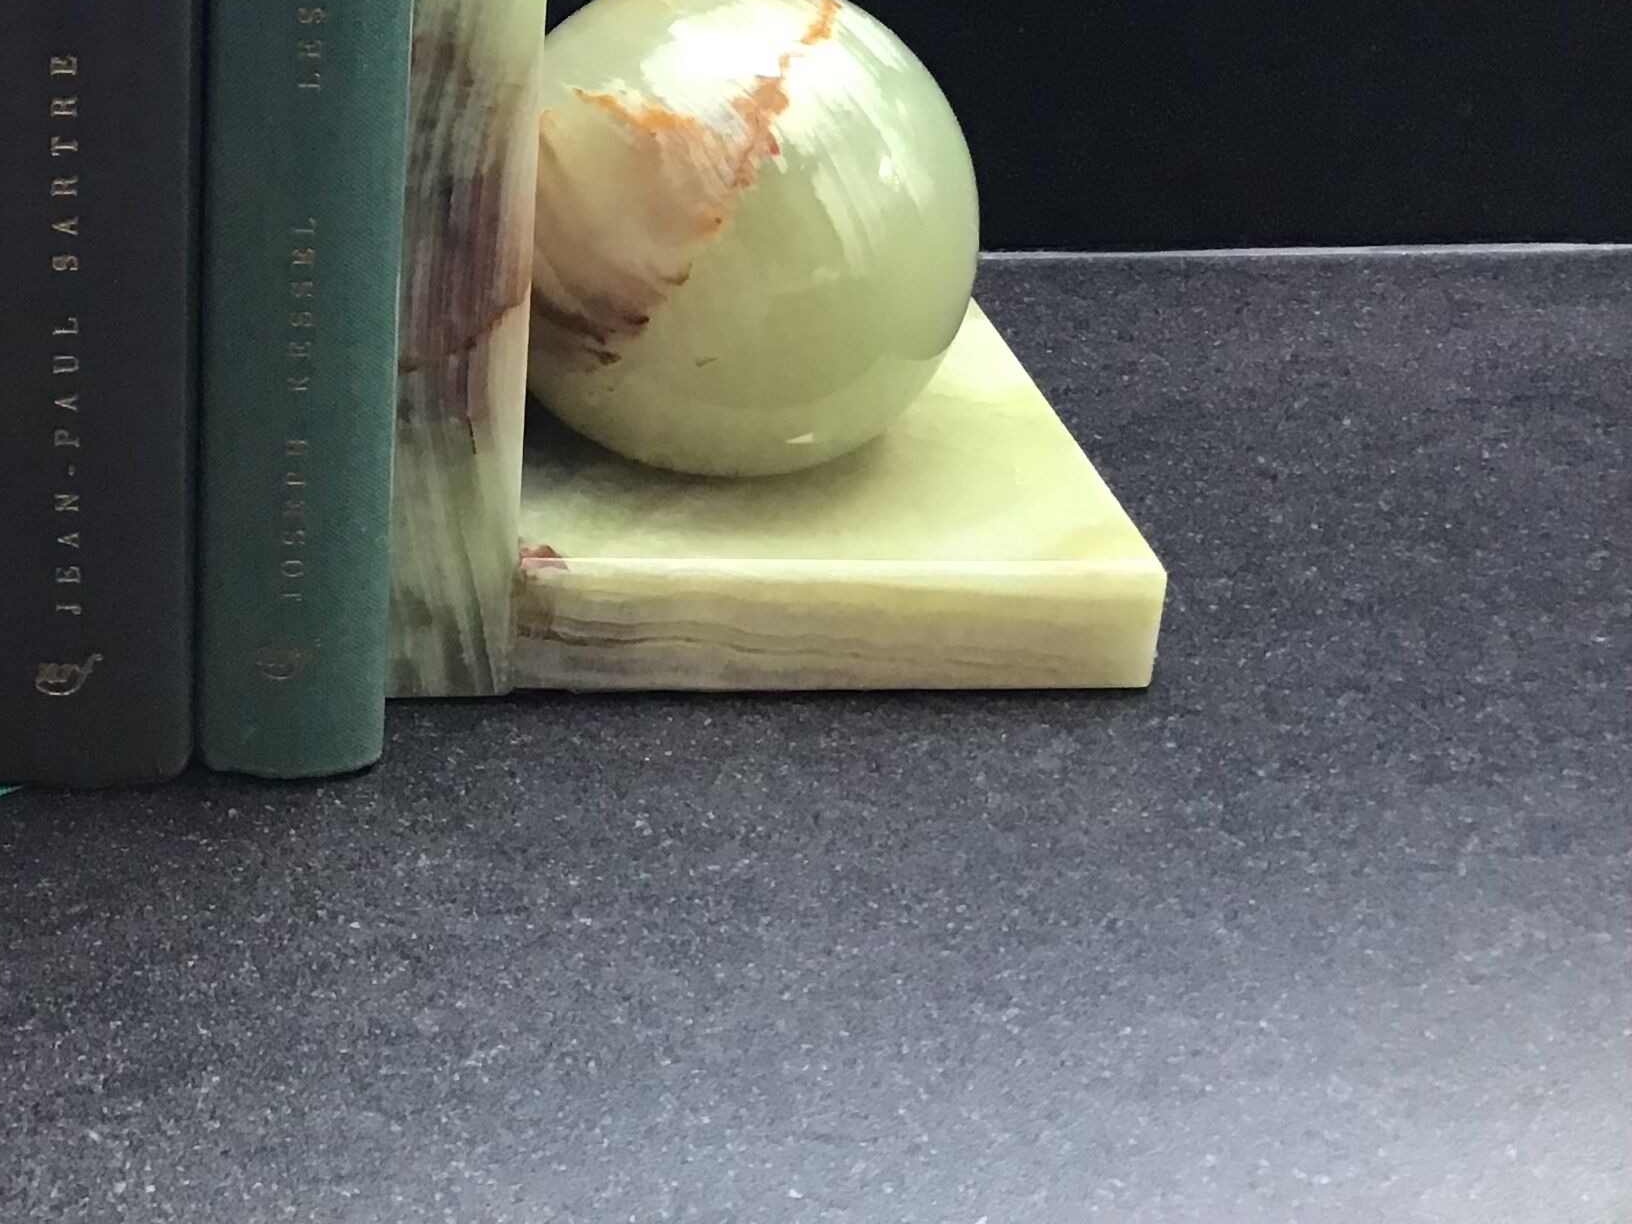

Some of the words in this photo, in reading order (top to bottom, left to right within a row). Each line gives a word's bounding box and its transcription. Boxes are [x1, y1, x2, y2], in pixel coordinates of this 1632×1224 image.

[297, 6, 326, 90] LES
[49, 54, 79, 272] SARTRE
[51, 316, 82, 616] JEAN-PAUL
